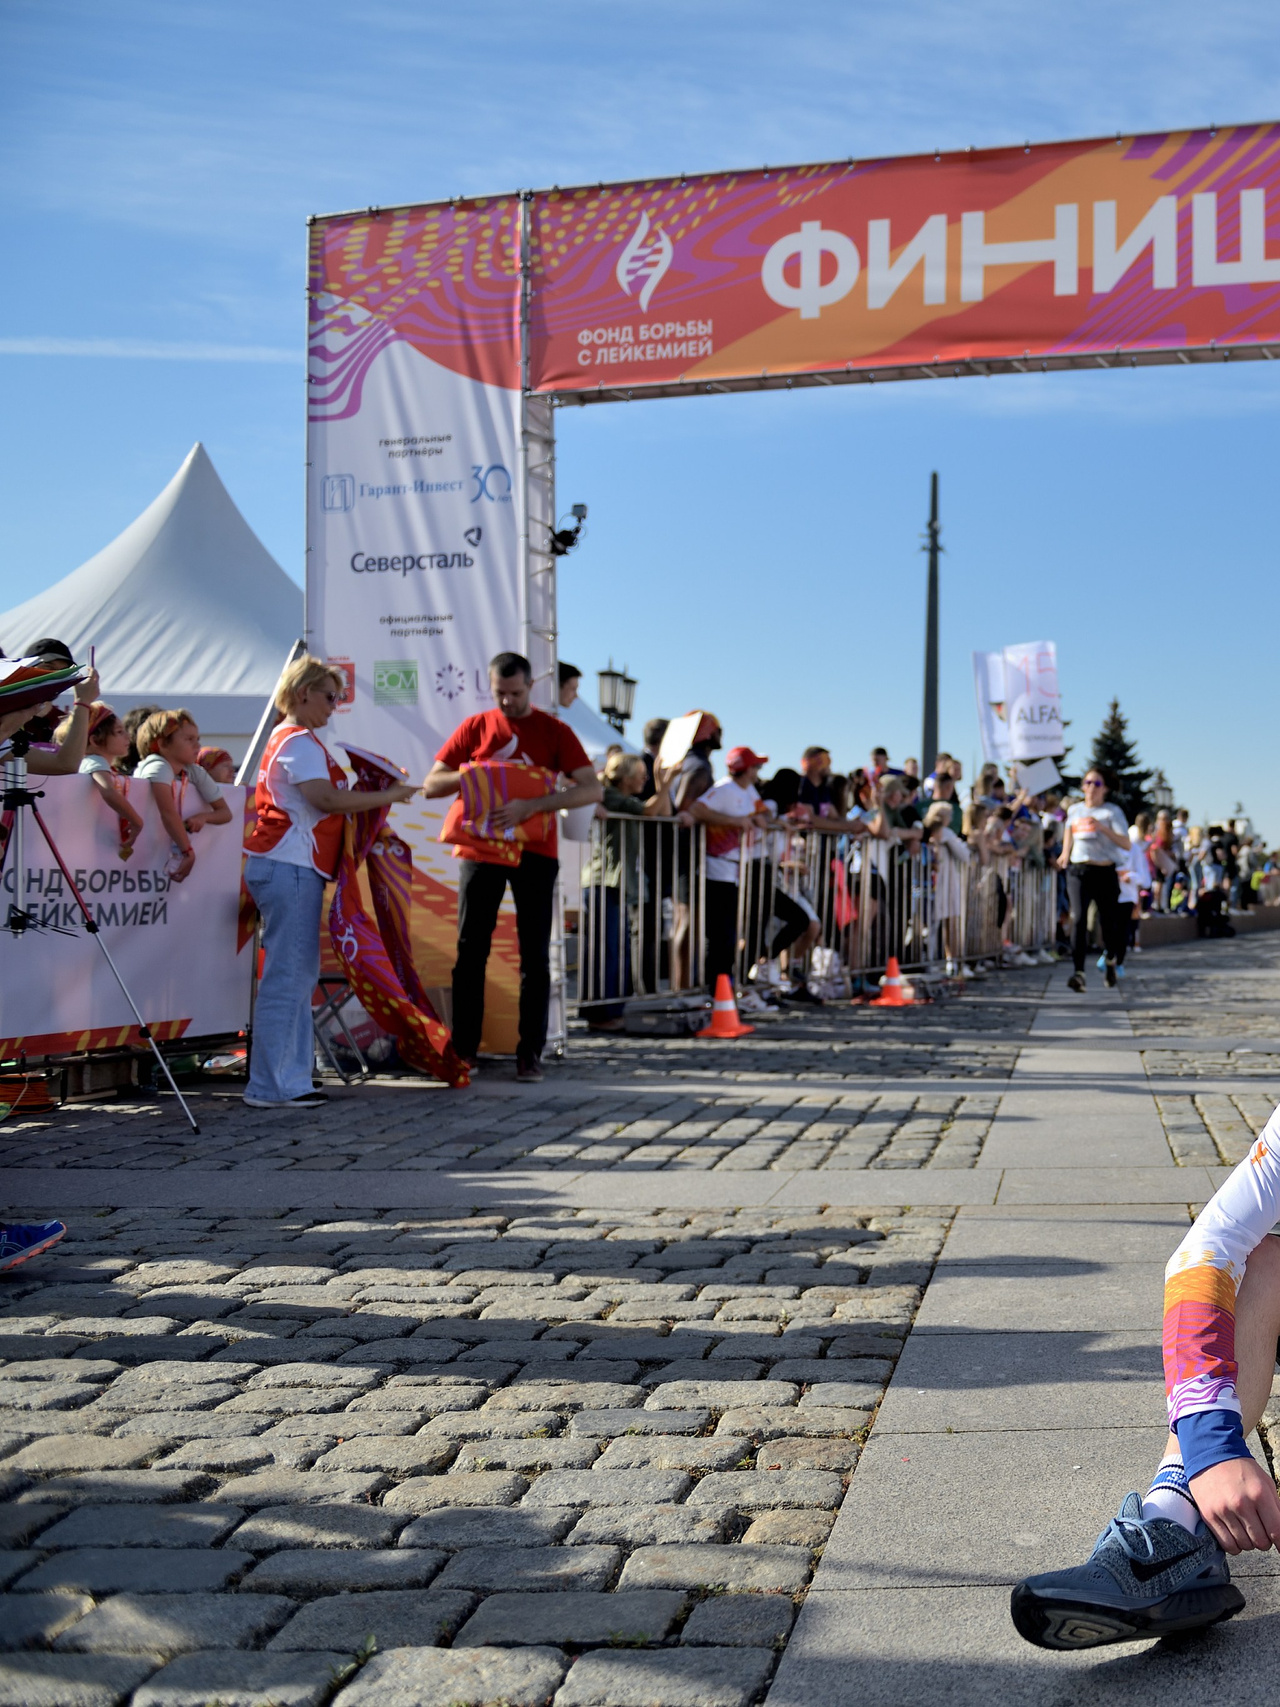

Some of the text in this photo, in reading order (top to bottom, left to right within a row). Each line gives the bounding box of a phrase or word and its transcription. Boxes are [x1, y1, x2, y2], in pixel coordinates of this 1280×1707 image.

[577, 319, 713, 346] ФОНД БОРЬБЫ
[577, 337, 714, 366] С ЛЕЙКЕМИЕЙ
[378, 434, 453, 448] генеральные
[358, 478, 465, 500] Гарант-Инвест
[350, 552, 475, 578] Северсталь
[379, 613, 454, 626] официальные
[2, 867, 172, 898] ОНД БОРЬБЫ
